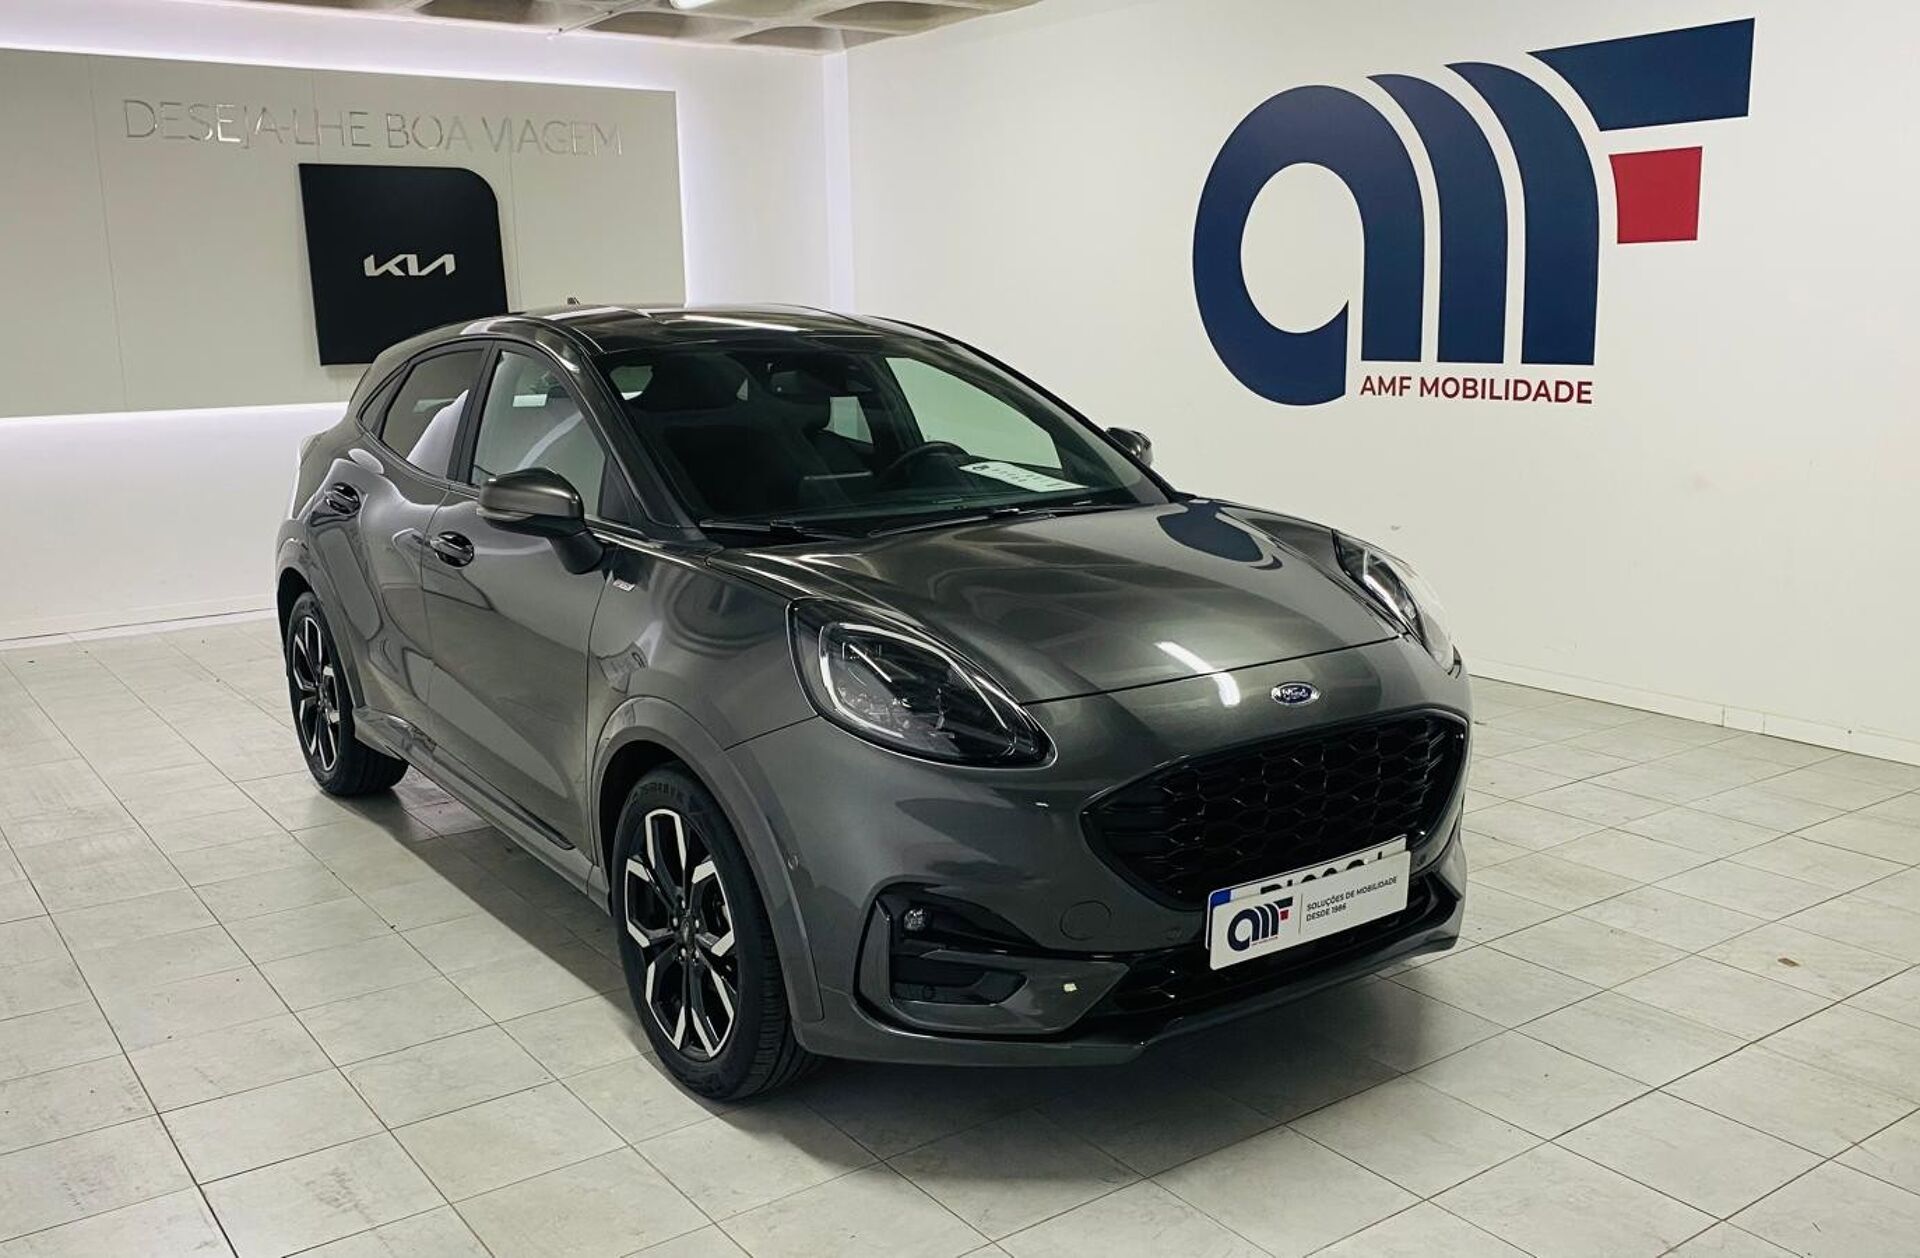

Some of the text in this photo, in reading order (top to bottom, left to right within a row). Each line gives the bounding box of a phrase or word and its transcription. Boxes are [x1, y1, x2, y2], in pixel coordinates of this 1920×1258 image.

[123, 98, 623, 158] DESEJA-LHE BOA VIAGEM
[1360, 375, 1593, 405] AMF MOBILIDADE
[1345, 889, 1355, 900] DE
[1356, 875, 1397, 896] MOBILIDADE
[1306, 908, 1330, 922] DESDE
